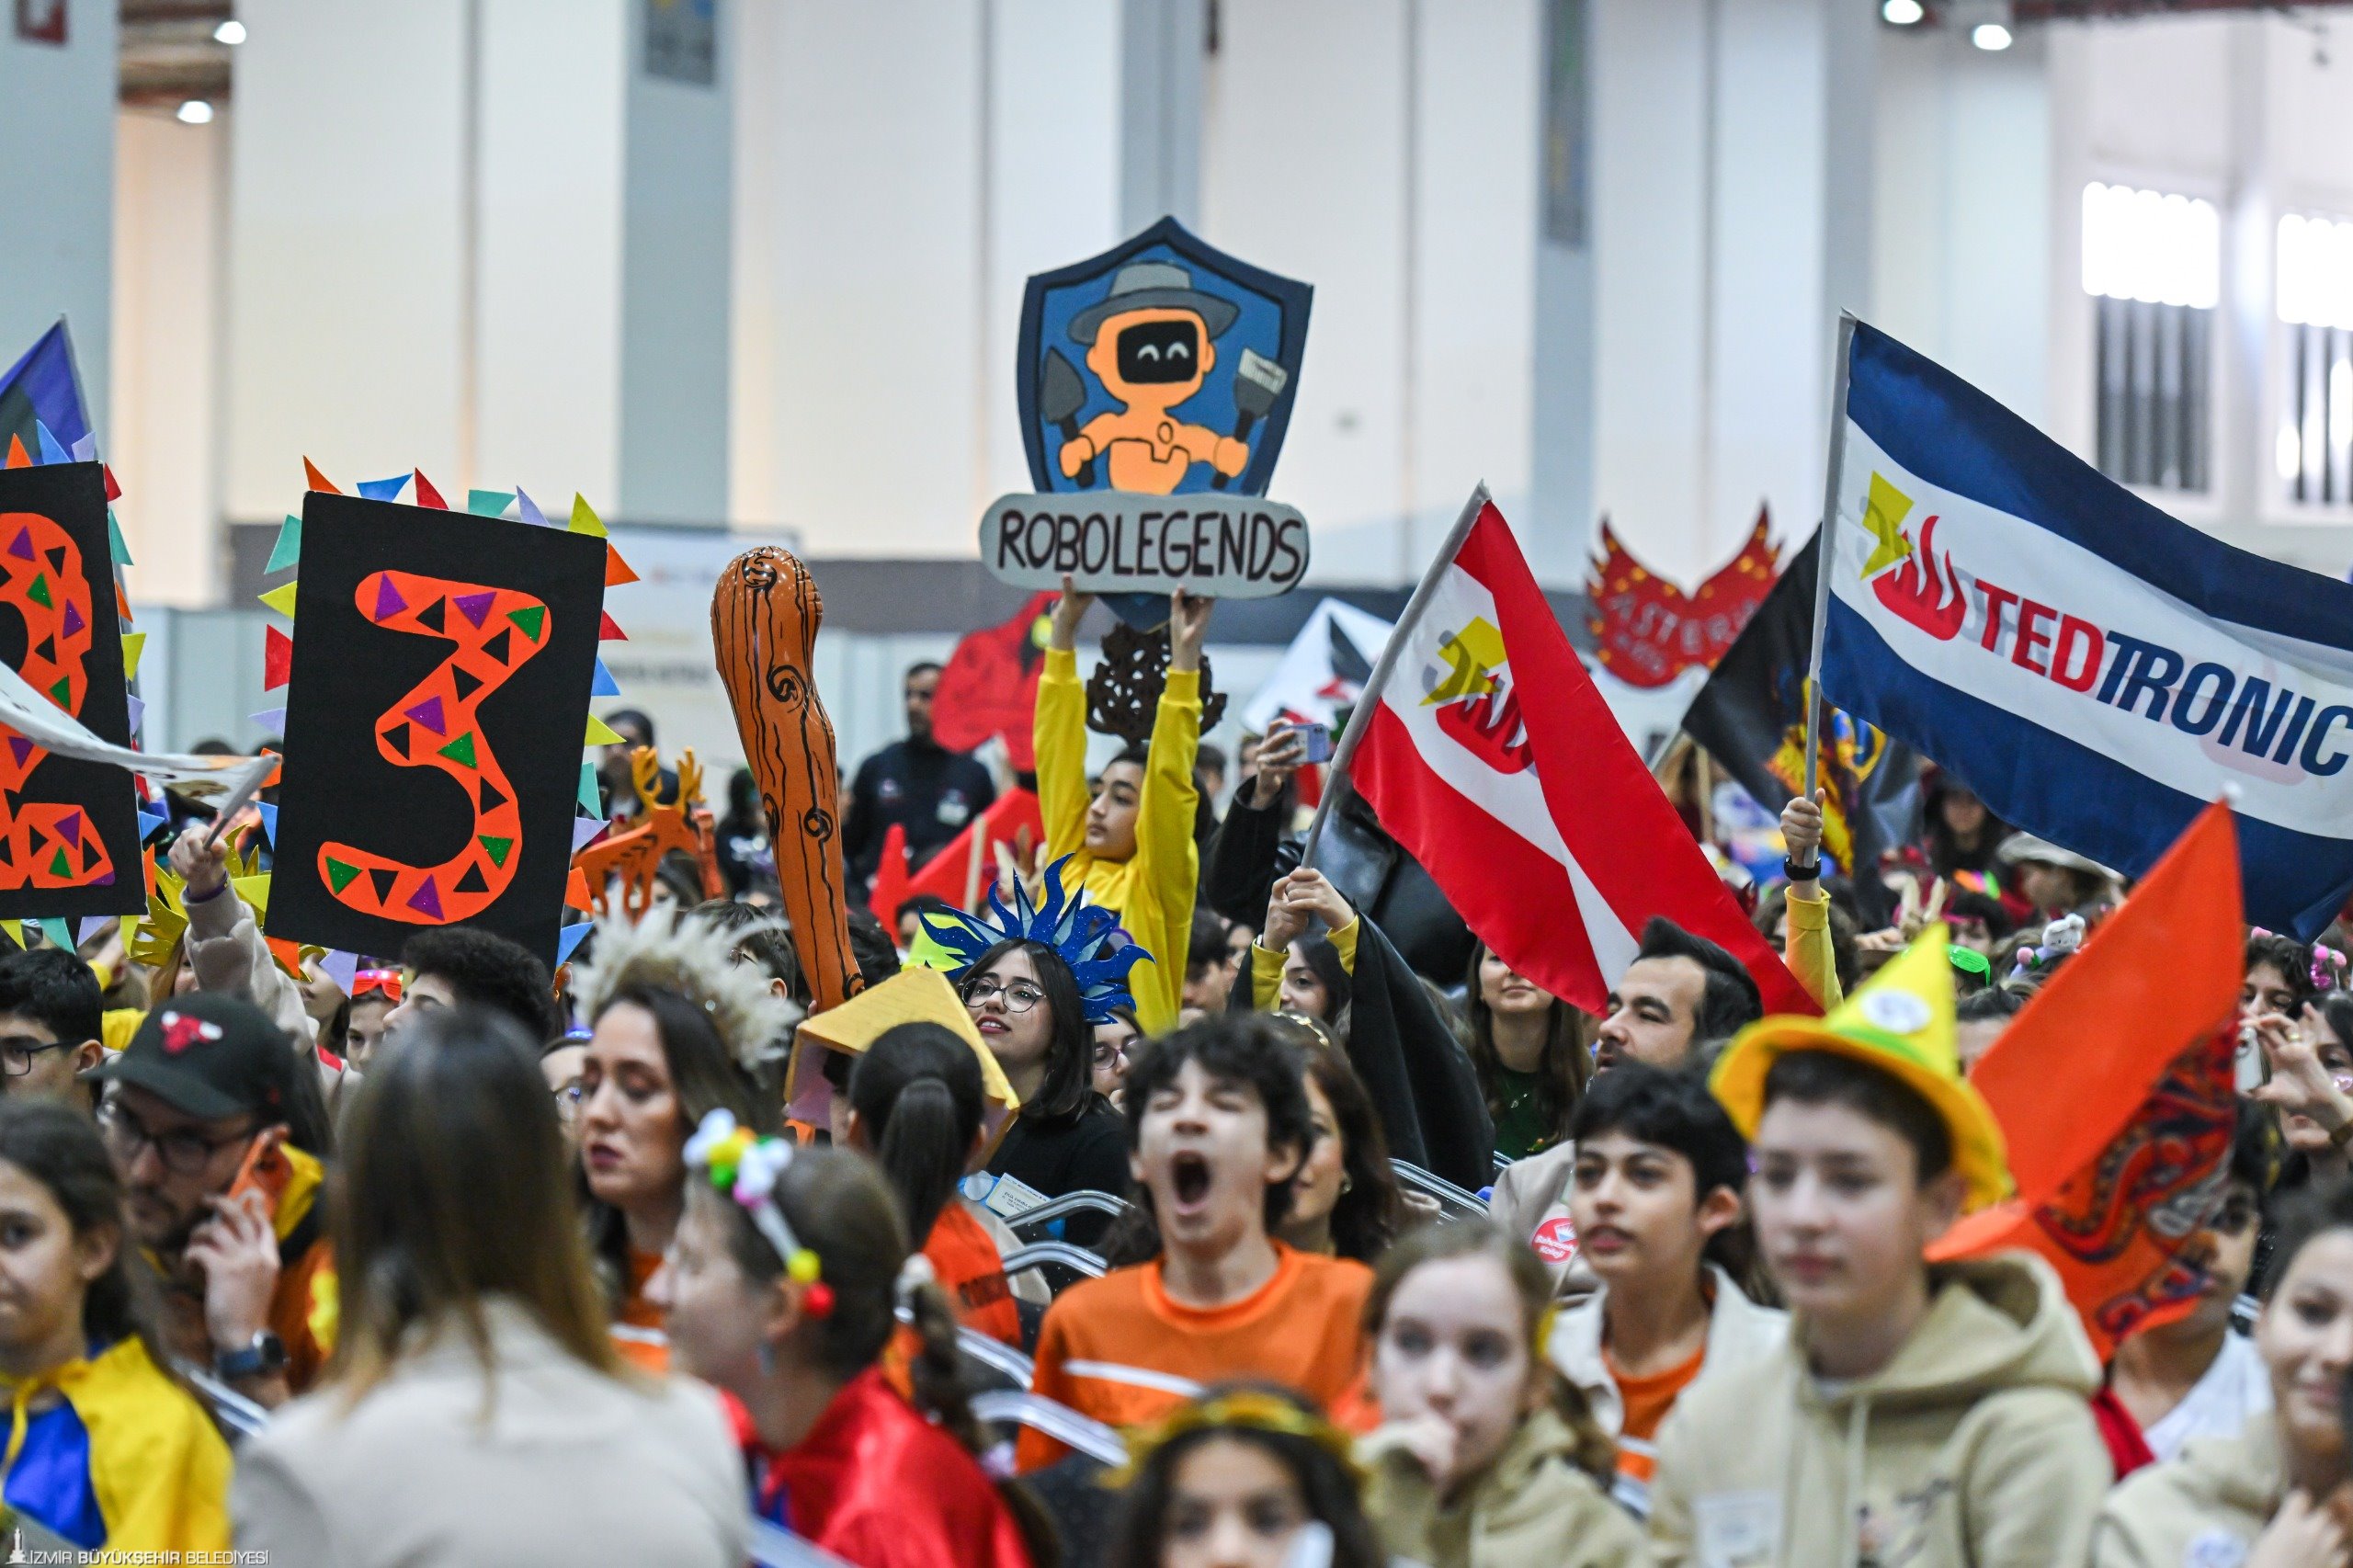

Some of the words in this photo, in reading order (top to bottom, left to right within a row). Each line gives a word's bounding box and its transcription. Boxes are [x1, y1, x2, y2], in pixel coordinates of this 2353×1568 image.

[998, 508, 1302, 584] ROBOLEGENDS
[317, 570, 552, 926] 3
[1974, 577, 2353, 777] TEDTRONIC
